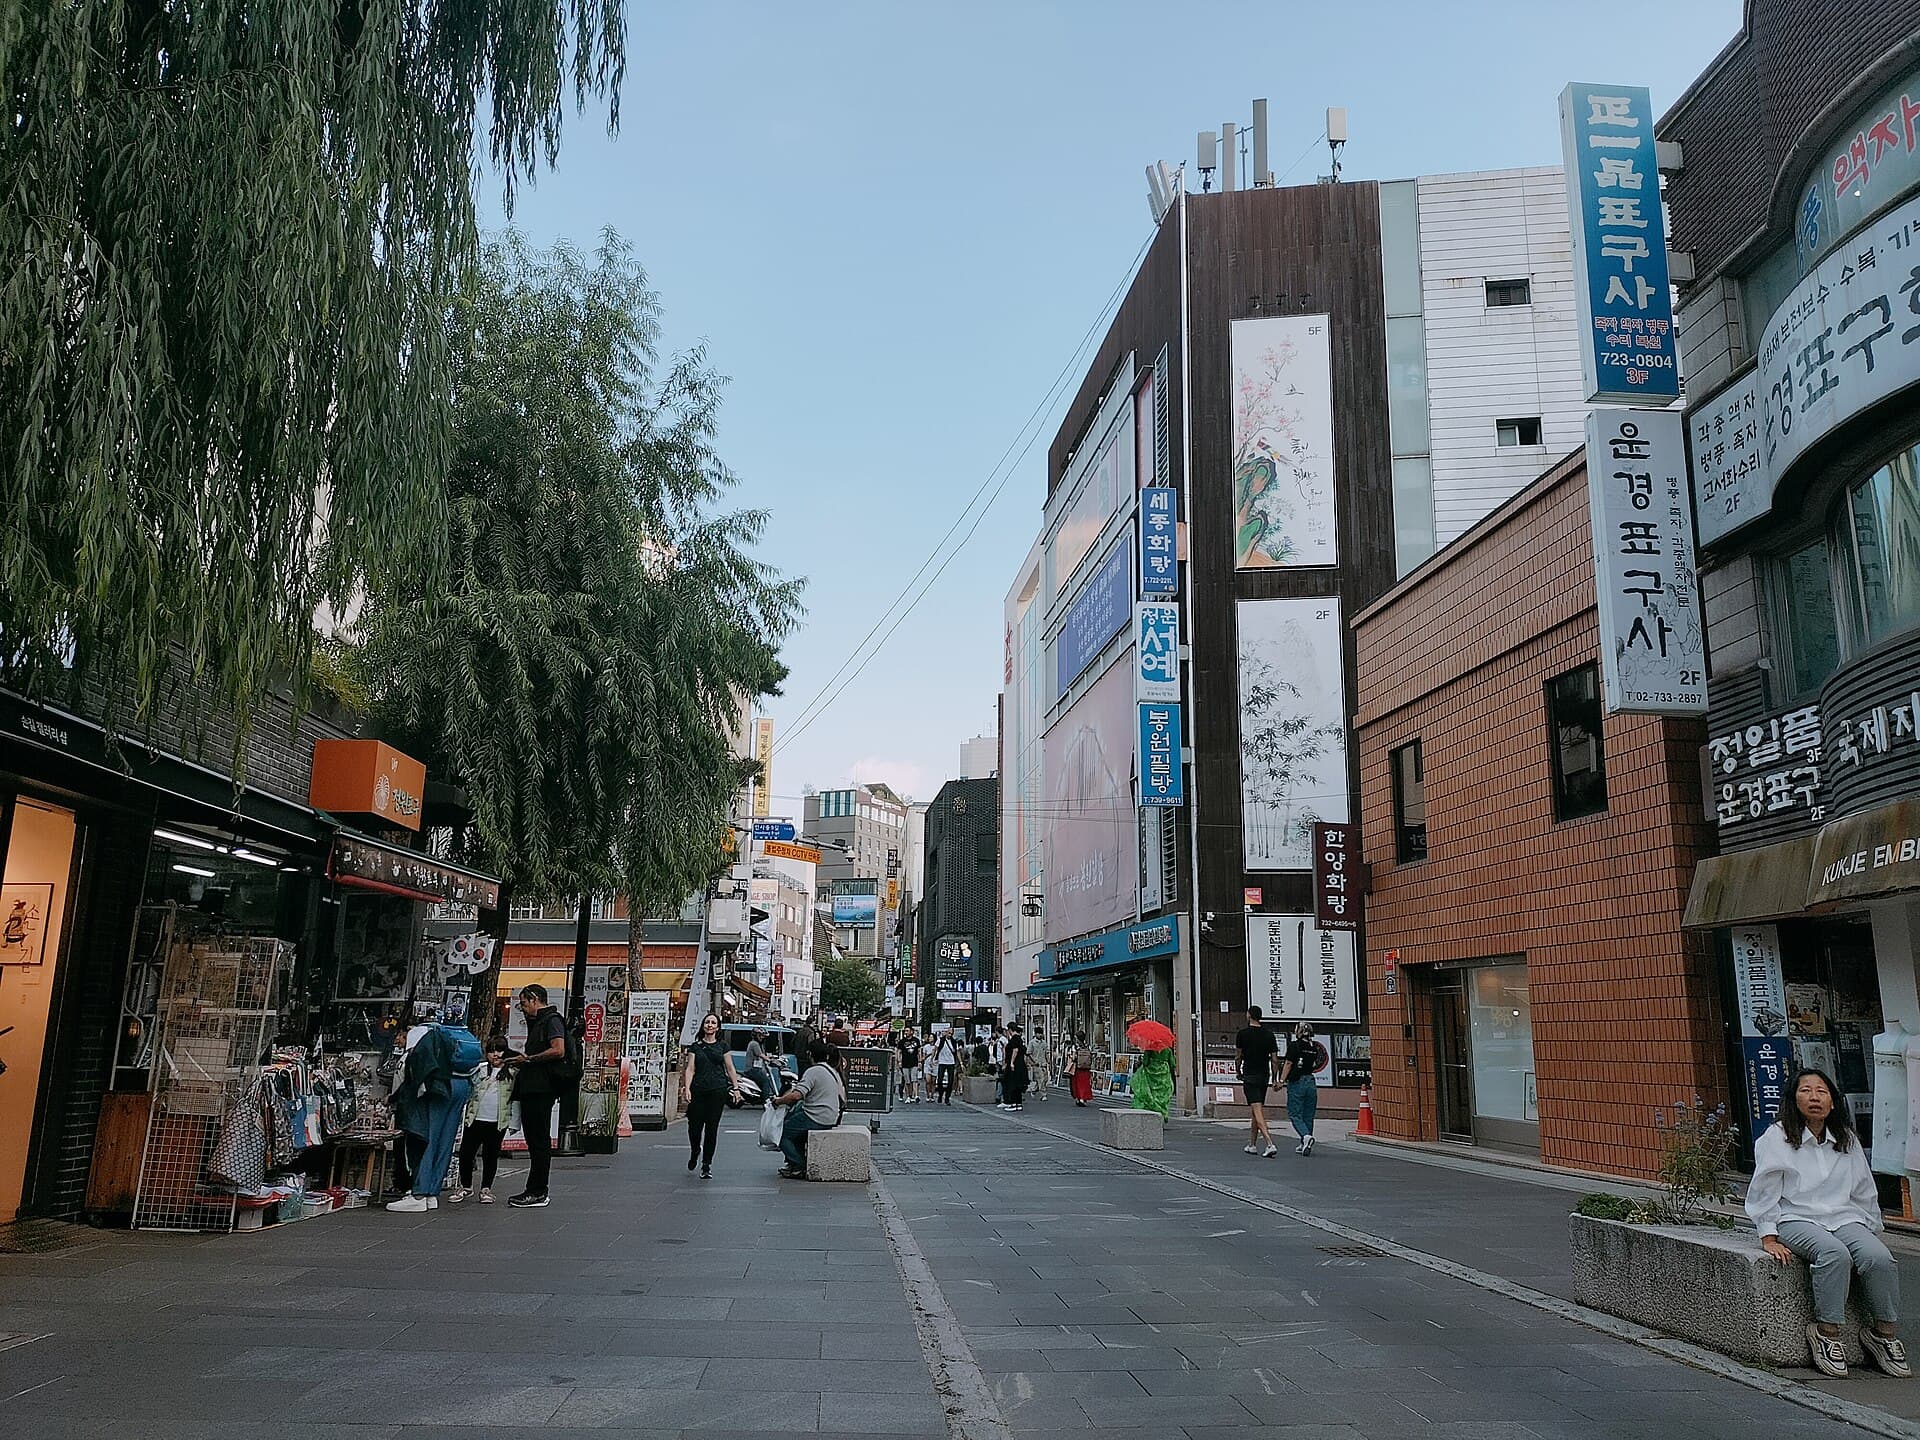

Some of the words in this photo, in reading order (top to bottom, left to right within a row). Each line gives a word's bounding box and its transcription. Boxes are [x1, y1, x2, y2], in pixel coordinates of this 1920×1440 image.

[1308, 326, 1322, 335] 5F
[1606, 334, 1632, 348] 수리
[1600, 352, 1673, 369] 723-0804
[1626, 367, 1649, 384] 3F
[1725, 493, 1741, 515] 2F
[1147, 492, 1172, 574] 세종화랑
[1609, 422, 1672, 657] 운경표구사
[1316, 610, 1330, 620] 2F
[1142, 625, 1177, 679] 서예
[1680, 670, 1701, 686] 2F
[1709, 705, 1822, 774] 정일품
[1806, 749, 1822, 764] 3F
[1717, 766, 1822, 827] 운경표구
[1810, 805, 1826, 821] 2F
[791, 848, 807, 858] CCTV
[1324, 830, 1348, 914] 한양화랑
[1822, 850, 1868, 887] KUKJE
[940, 949, 960, 963] 마루
